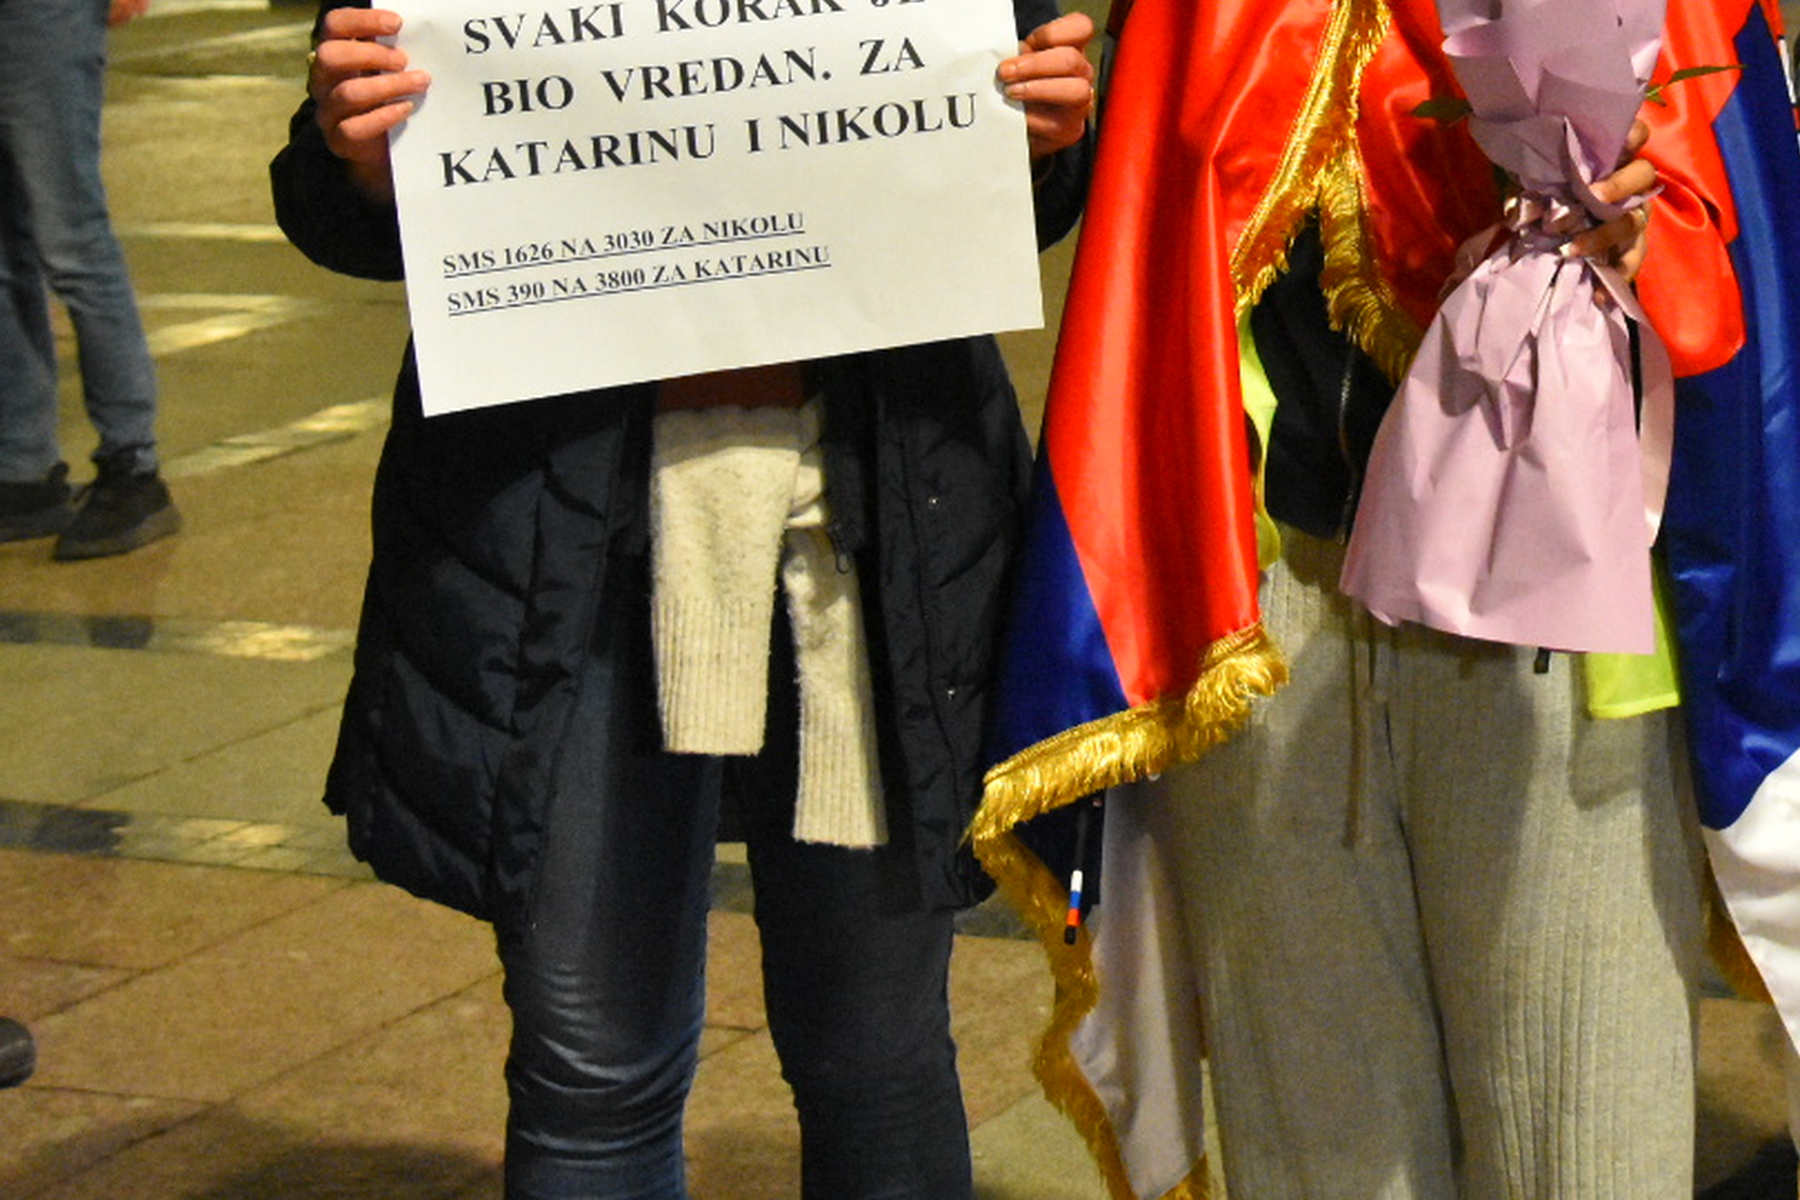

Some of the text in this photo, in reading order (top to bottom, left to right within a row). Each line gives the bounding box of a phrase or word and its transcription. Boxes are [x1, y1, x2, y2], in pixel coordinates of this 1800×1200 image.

[463, 2, 624, 55] SVAKI
[482, 37, 926, 117] BIO VREDAN. ZA
[438, 93, 977, 188] KATARINU I NIKOLU
[443, 212, 804, 275] SMS 1626 NA 3030 ZA NIKOLU
[447, 245, 831, 313] SMS 390 NA 3800 ZA KATARINU
